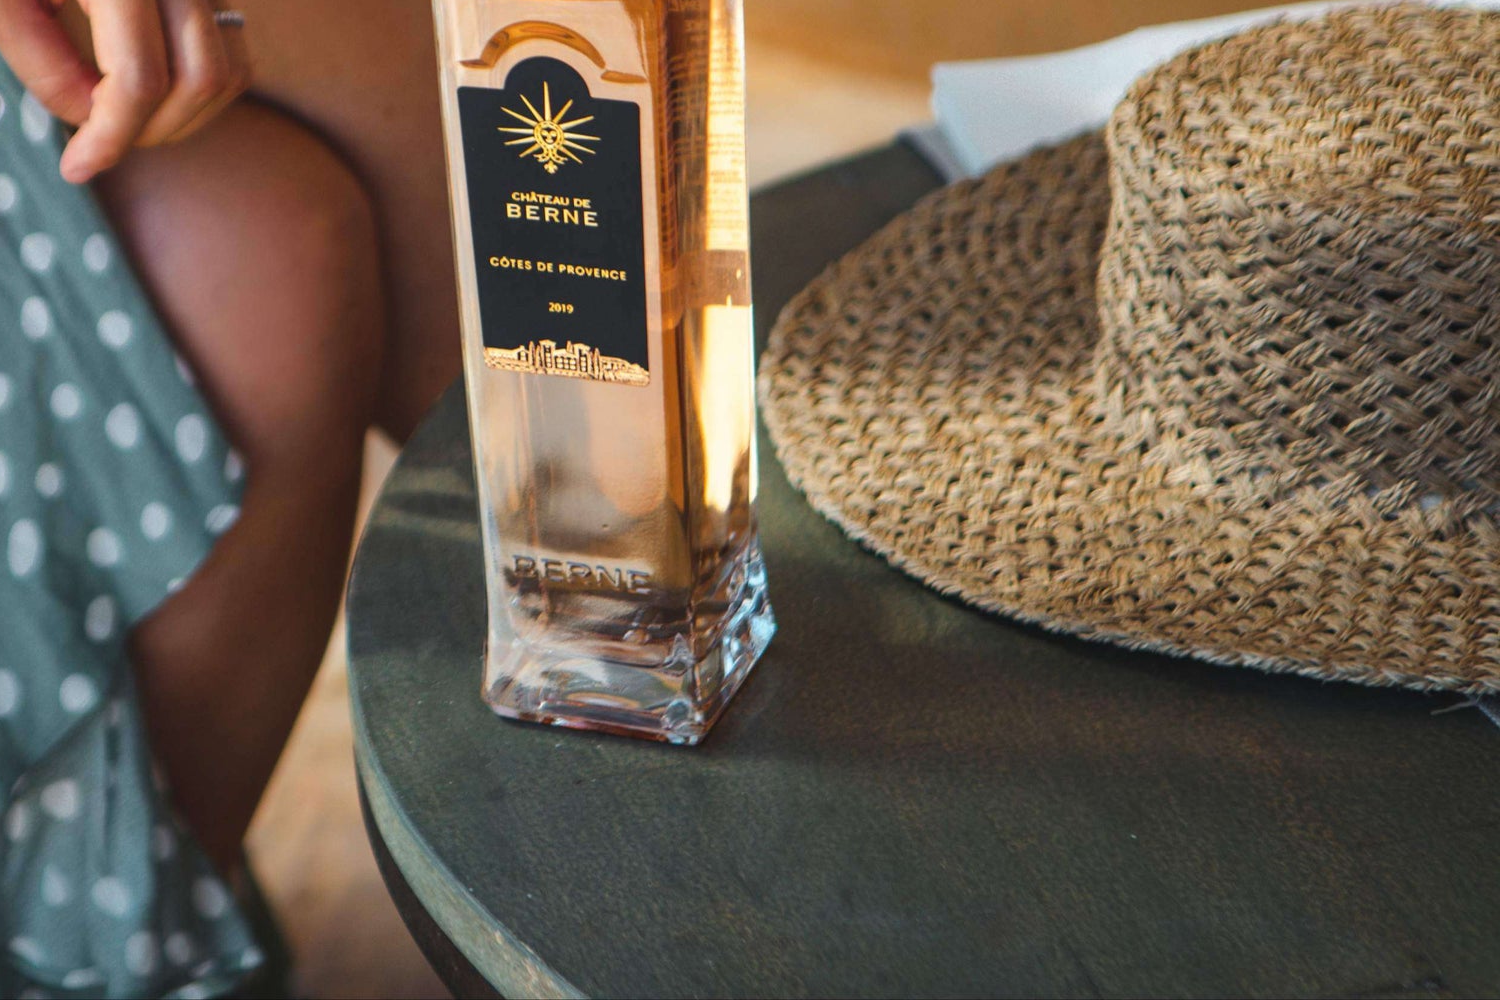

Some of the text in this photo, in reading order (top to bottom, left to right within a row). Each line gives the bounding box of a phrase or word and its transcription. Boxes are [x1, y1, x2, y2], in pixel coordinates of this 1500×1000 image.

[511, 191, 592, 209] CHÂTEAU DE
[506, 202, 599, 227] BERNE
[489, 256, 627, 281] CÔTES DE PROVENCE
[548, 302, 574, 314] 2019
[513, 554, 652, 595] BERNE
